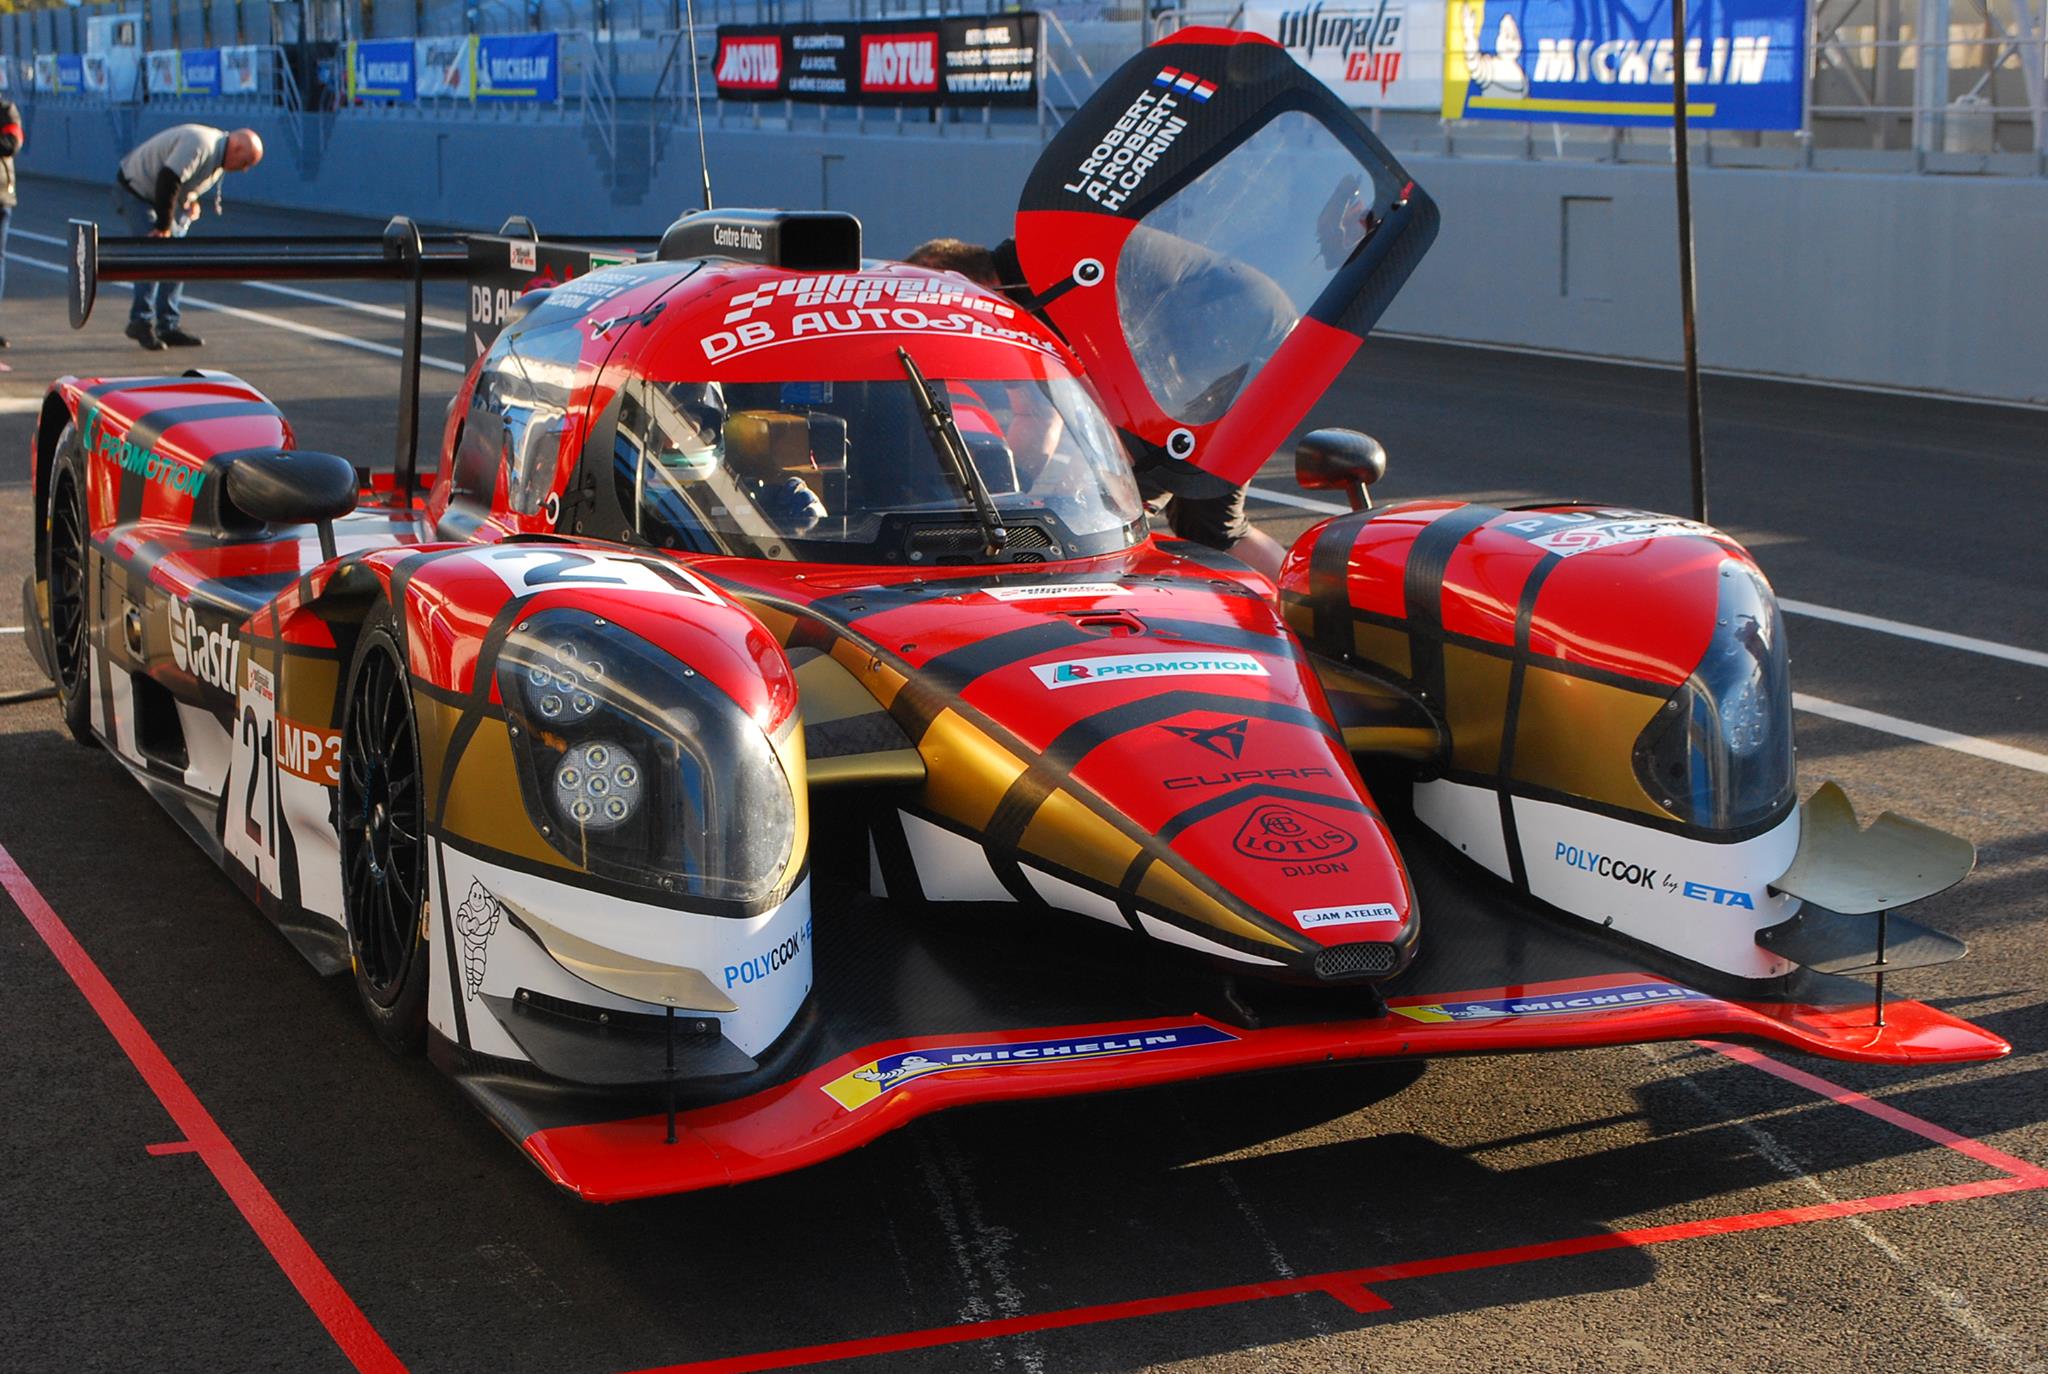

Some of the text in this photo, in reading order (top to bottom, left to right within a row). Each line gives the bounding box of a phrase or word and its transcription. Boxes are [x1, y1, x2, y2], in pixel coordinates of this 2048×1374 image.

[718, 42, 779, 83] MOTUL
[864, 41, 935, 85] MOTUL
[1533, 36, 1771, 85] MICHELIN
[1064, 89, 1157, 194] L.ROBERT
[1086, 93, 1178, 202] A.ROBERT
[1101, 115, 1188, 212] H.CARINI
[713, 223, 762, 250] Centre fruits
[471, 285, 492, 324] DB
[700, 321, 776, 361] DB
[98, 432, 207, 499] PROMOTION
[491, 549, 706, 597] 21
[1096, 661, 1259, 677] PROMOTION
[276, 718, 343, 782] LMP3
[242, 704, 276, 861] 21
[1163, 767, 1333, 790] CUPRA
[1245, 830, 1345, 854] LOTUS
[1281, 862, 1350, 877] DIJON
[1555, 841, 1755, 911] POLYCOOK by ETA
[1344, 907, 1393, 920] ATELIER
[724, 931, 800, 989] POLYCOOK
[951, 1034, 1177, 1063] MICHELIN
